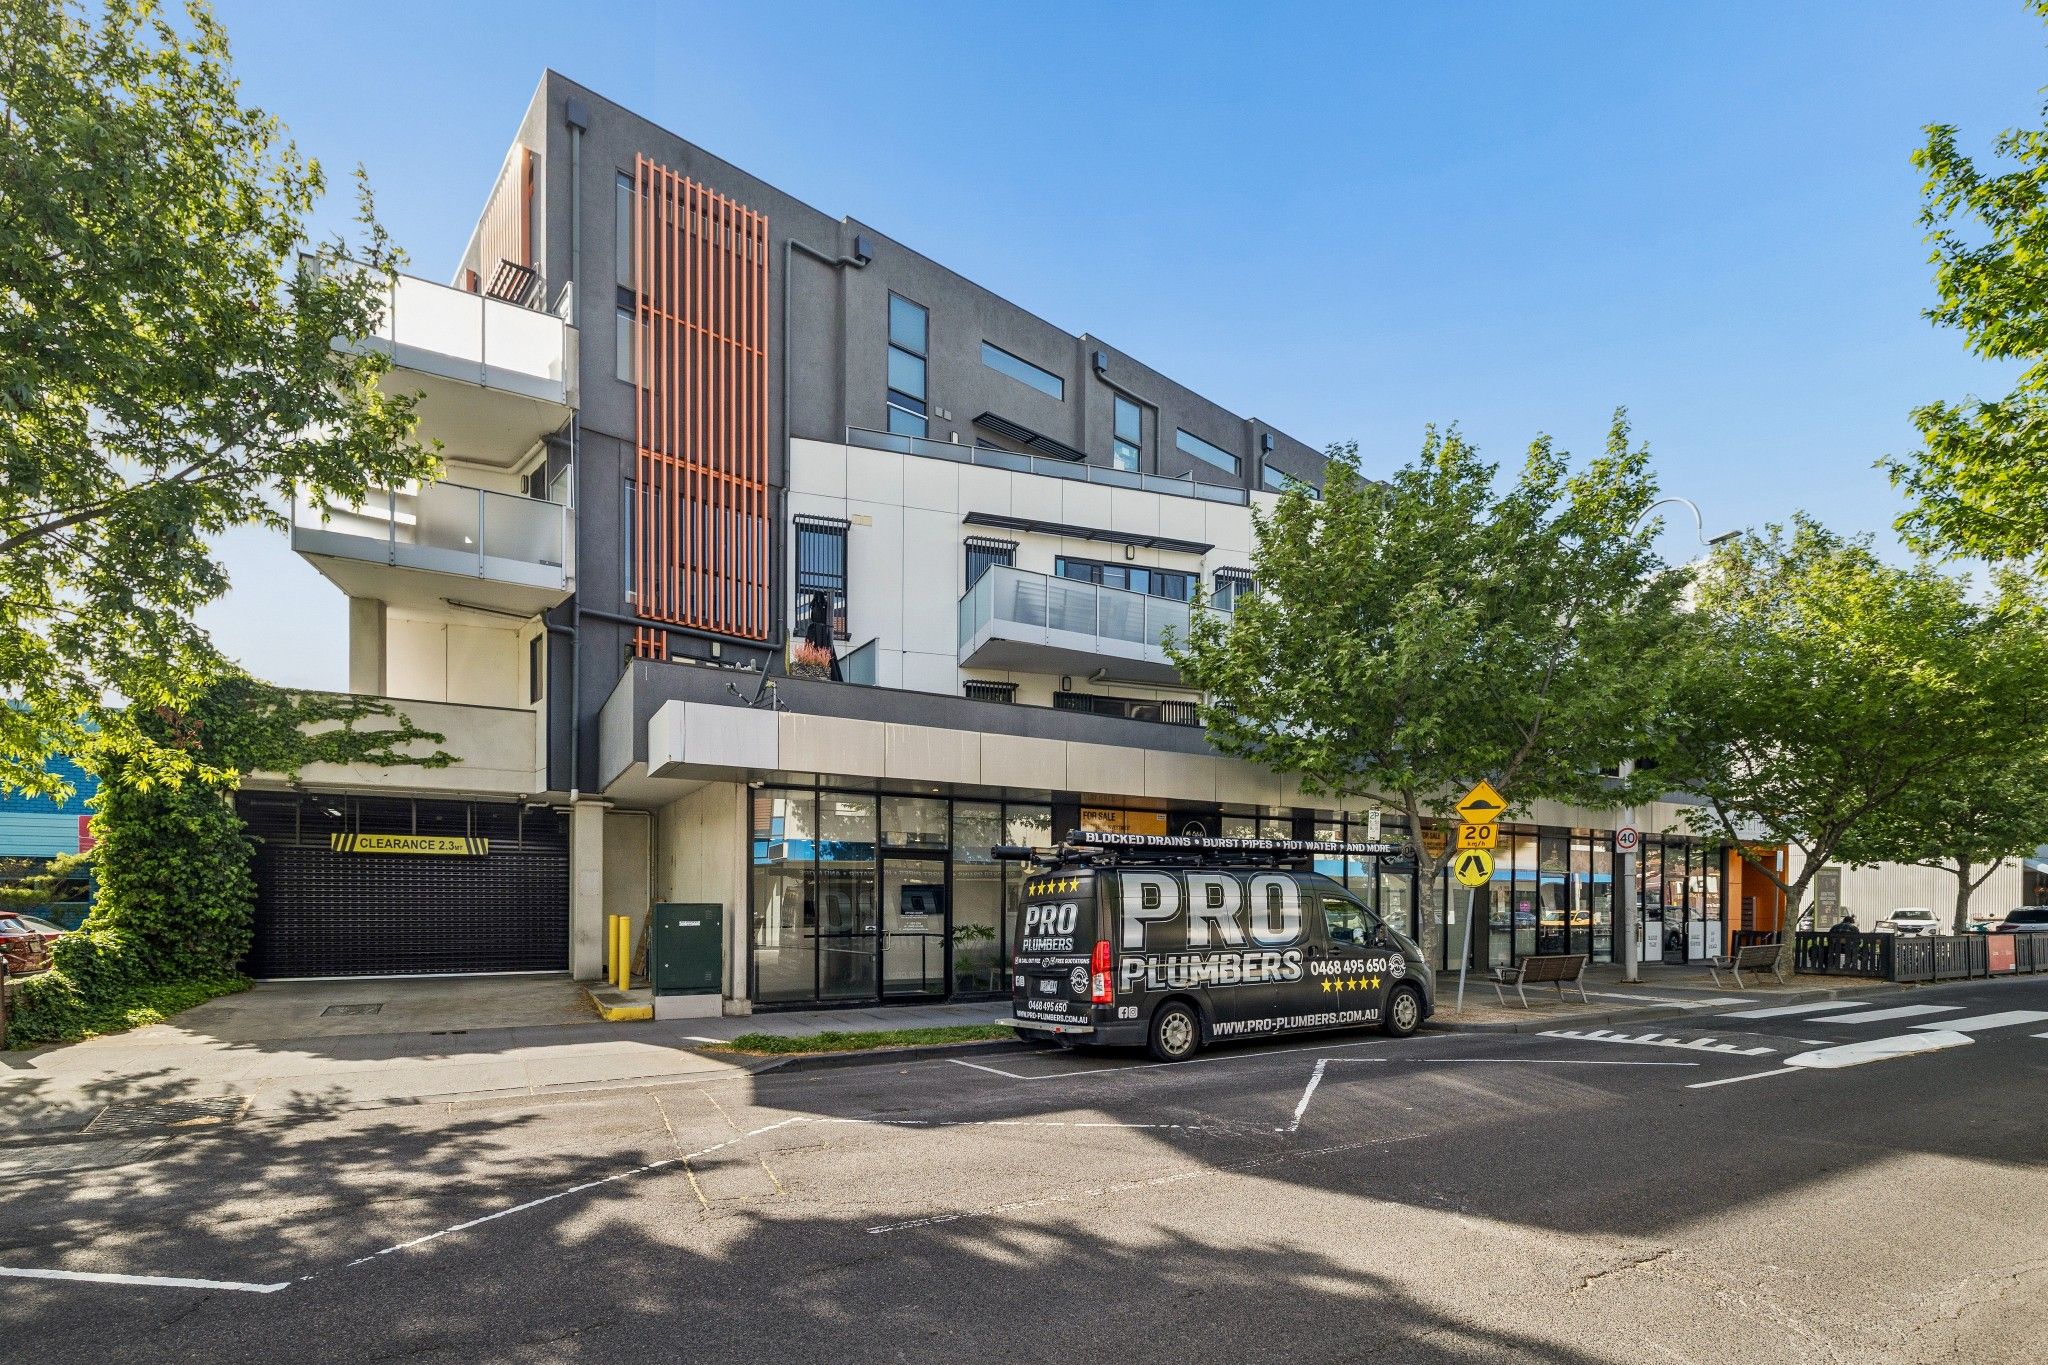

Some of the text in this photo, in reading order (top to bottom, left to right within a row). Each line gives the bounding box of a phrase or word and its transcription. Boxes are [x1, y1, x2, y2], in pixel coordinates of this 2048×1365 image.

[1083, 811, 1116, 822] FOR SALE
[1465, 825, 1491, 840] 20
[1619, 832, 1635, 844] 40
[359, 837, 435, 850] CLEARANCE
[1085, 832, 1391, 853] BLOCKED DRAINS BURST PIPES HOT WATER AND MORE
[1117, 869, 1302, 952] PRO
[1024, 902, 1079, 936] PRO
[1022, 937, 1074, 951] PLUMBERS
[1118, 948, 1304, 994] PLUMBERS
[1310, 960, 1342, 976] 0468
[1343, 959, 1365, 974] 495
[1366, 958, 1387, 972] 650
[1028, 1000, 1067, 1012] 0468 495 650
[1016, 1010, 1088, 1024] WWW.PRO-PLUMBERS.COM.AU
[1212, 1008, 1378, 1036] WWW.PRO-PLUMBERS.COM.AU
